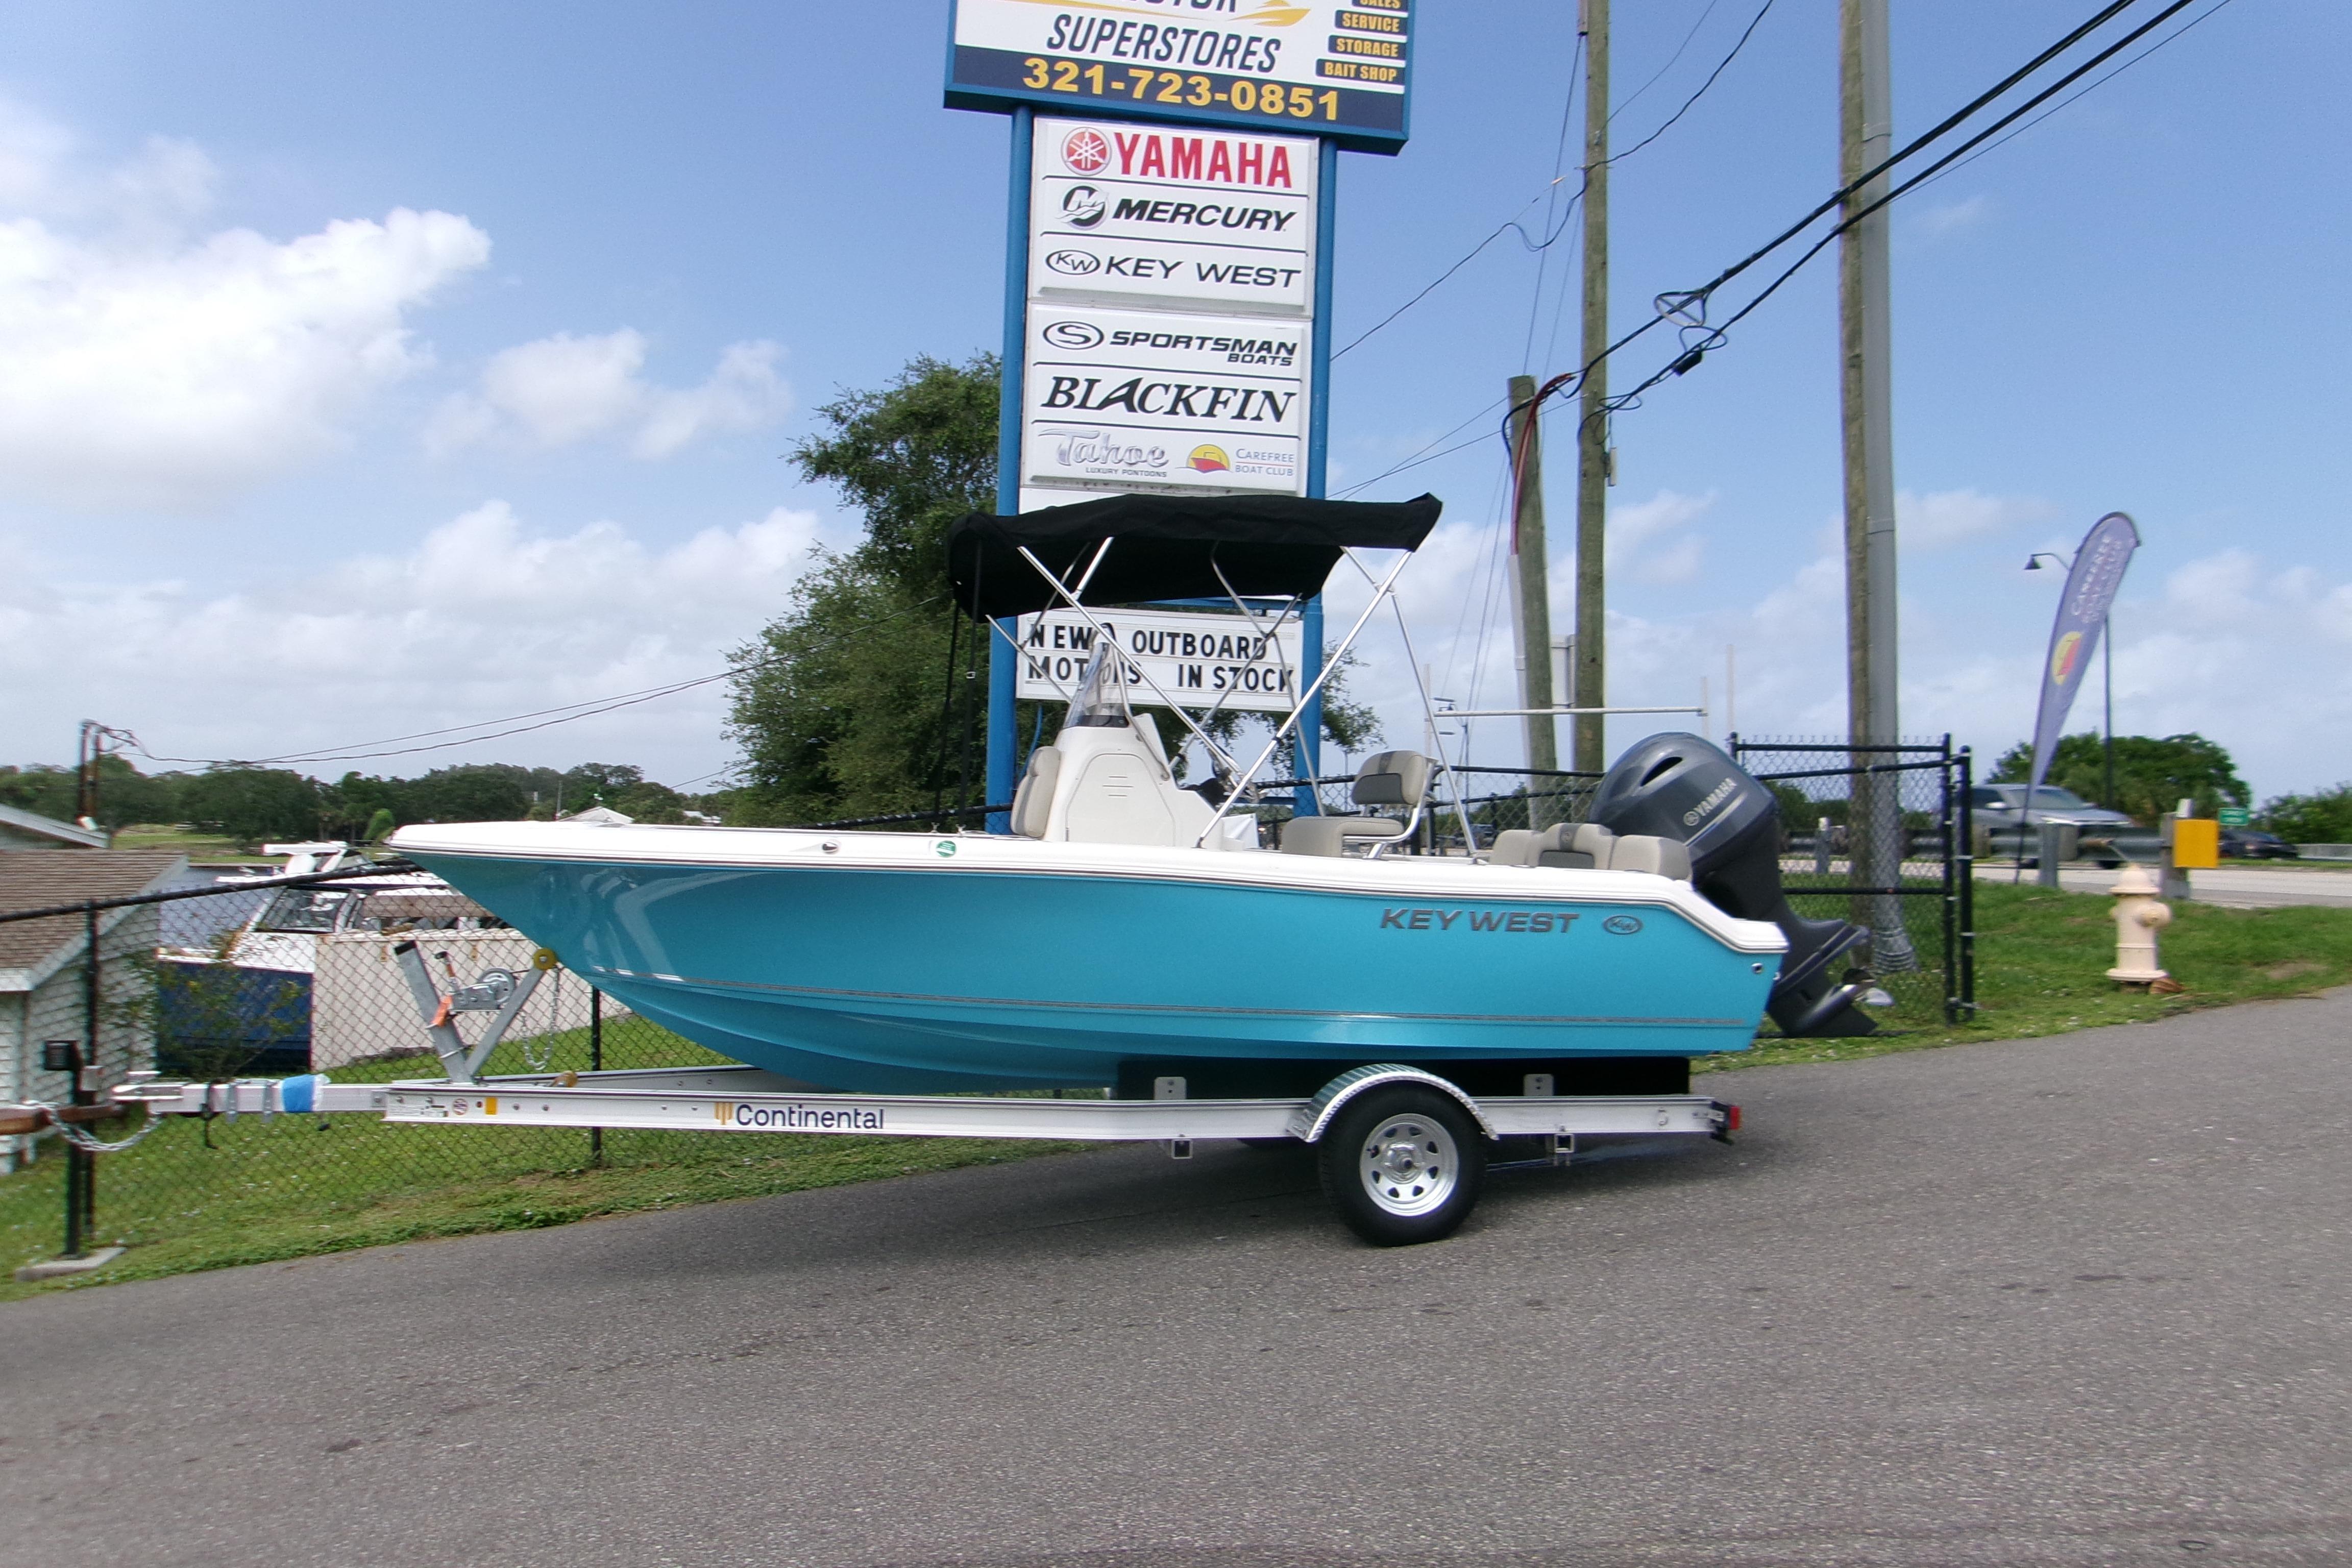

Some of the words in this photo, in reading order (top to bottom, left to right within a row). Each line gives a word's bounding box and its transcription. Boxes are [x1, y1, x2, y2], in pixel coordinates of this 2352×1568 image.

[1342, 13, 1400, 32] SERVICE
[1047, 14, 1281, 73] SUPERSTORES
[1336, 38, 1399, 57] STORAGE
[1324, 62, 1357, 78] BAIT
[1360, 65, 1397, 82] SHOP
[1022, 58, 1339, 121] 321-723-0851
[1113, 132, 1292, 188] YAMAHA
[1112, 198, 1296, 232] MERCURY
[1055, 253, 1094, 272] KW
[1105, 256, 1183, 279] KEY
[1196, 262, 1302, 288] WEST
[1110, 330, 1298, 357] SPORTSMAN
[1227, 353, 1293, 366] BOATS
[1041, 376, 1297, 423] BLACKFIN
[1038, 428, 1169, 468] Tahoe
[1235, 448, 1294, 463] CAREFREE
[1122, 469, 1167, 478] PONTOONS
[1235, 464, 1264, 474] BOAT
[1265, 465, 1294, 477] CLUB
[1030, 623, 1093, 650] NEW
[1132, 629, 1267, 660] OUTBOARD
[1178, 664, 1202, 688] IN
[1212, 666, 1294, 692] STOCK
[1693, 777, 1737, 817] YAMAHA
[1381, 908, 1462, 930] KEY
[1468, 911, 1580, 933] WEST
[737, 1104, 884, 1129] Continental
